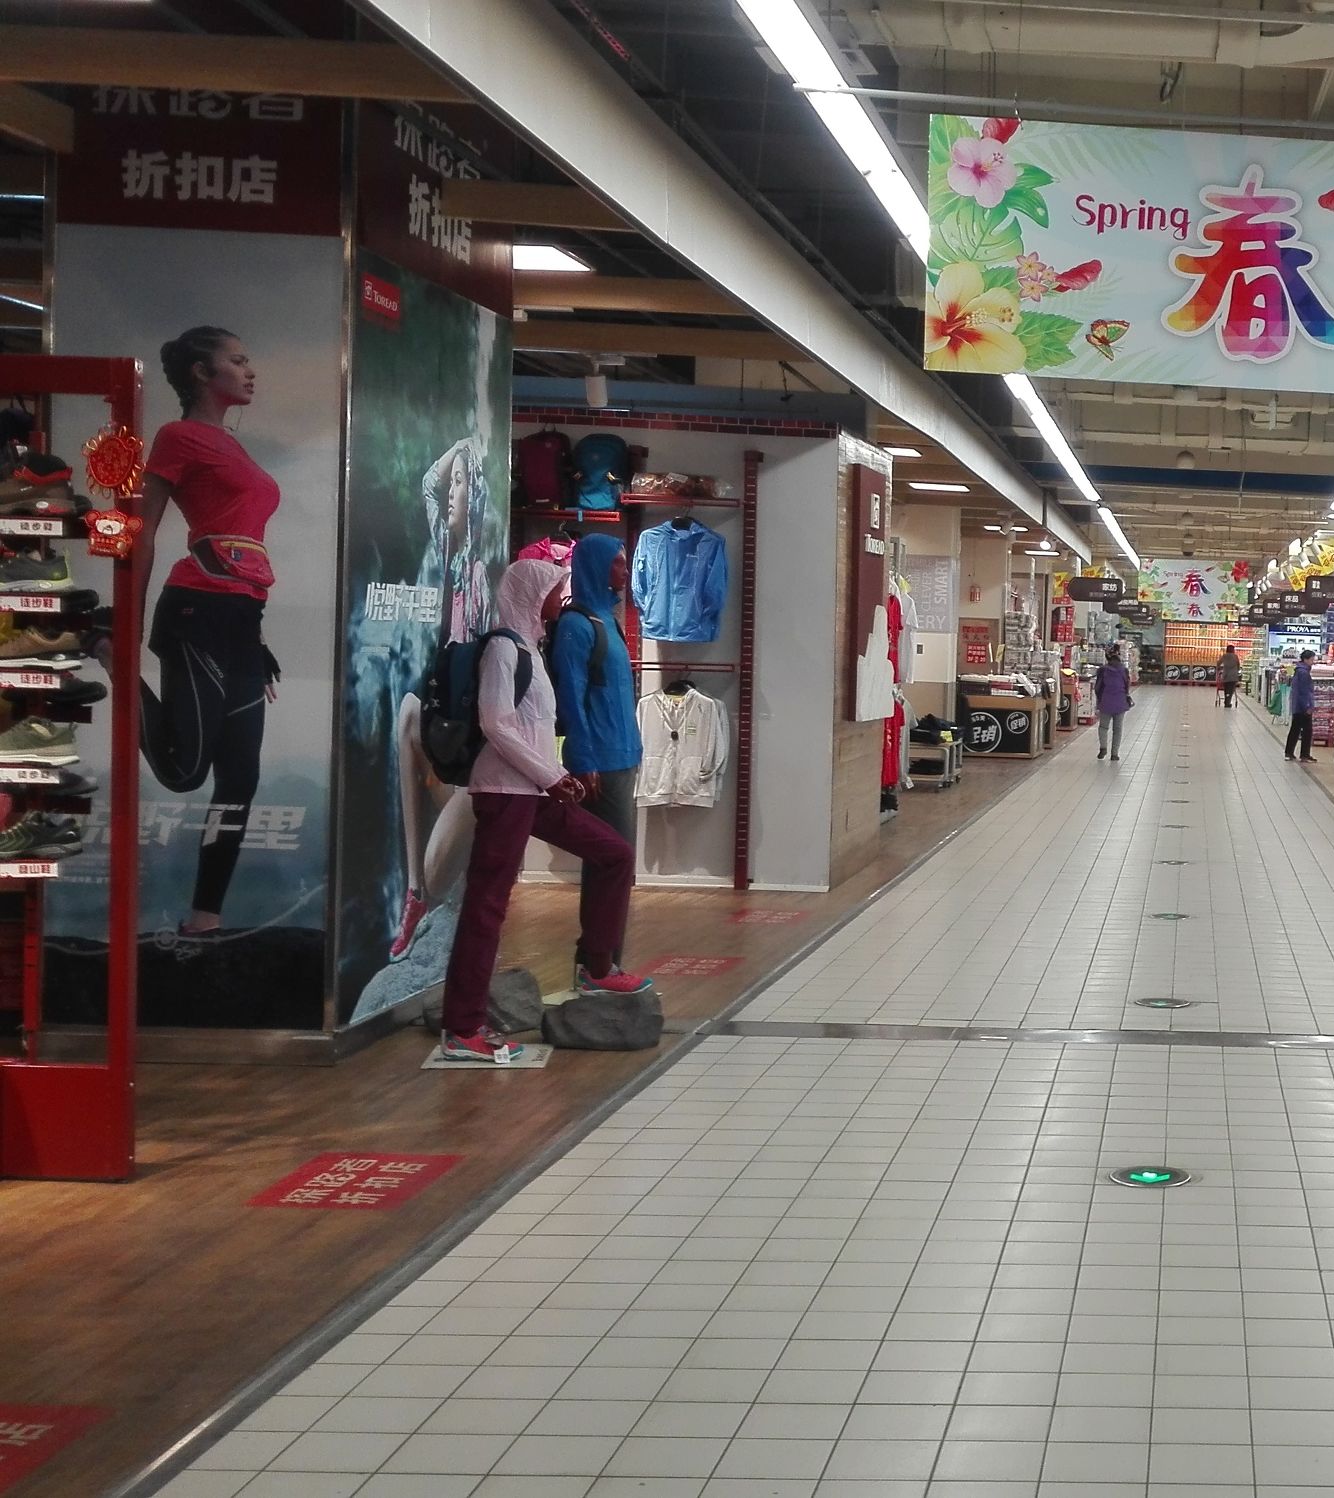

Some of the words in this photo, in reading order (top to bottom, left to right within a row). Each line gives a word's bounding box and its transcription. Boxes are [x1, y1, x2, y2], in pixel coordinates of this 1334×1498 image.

[121, 150, 278, 204] 折扣店
[1074, 193, 1191, 240] Spring
[372, 289, 399, 312] TOREAD
[364, 581, 439, 624] 悦野千里
[1180, 567, 1212, 598] 春
